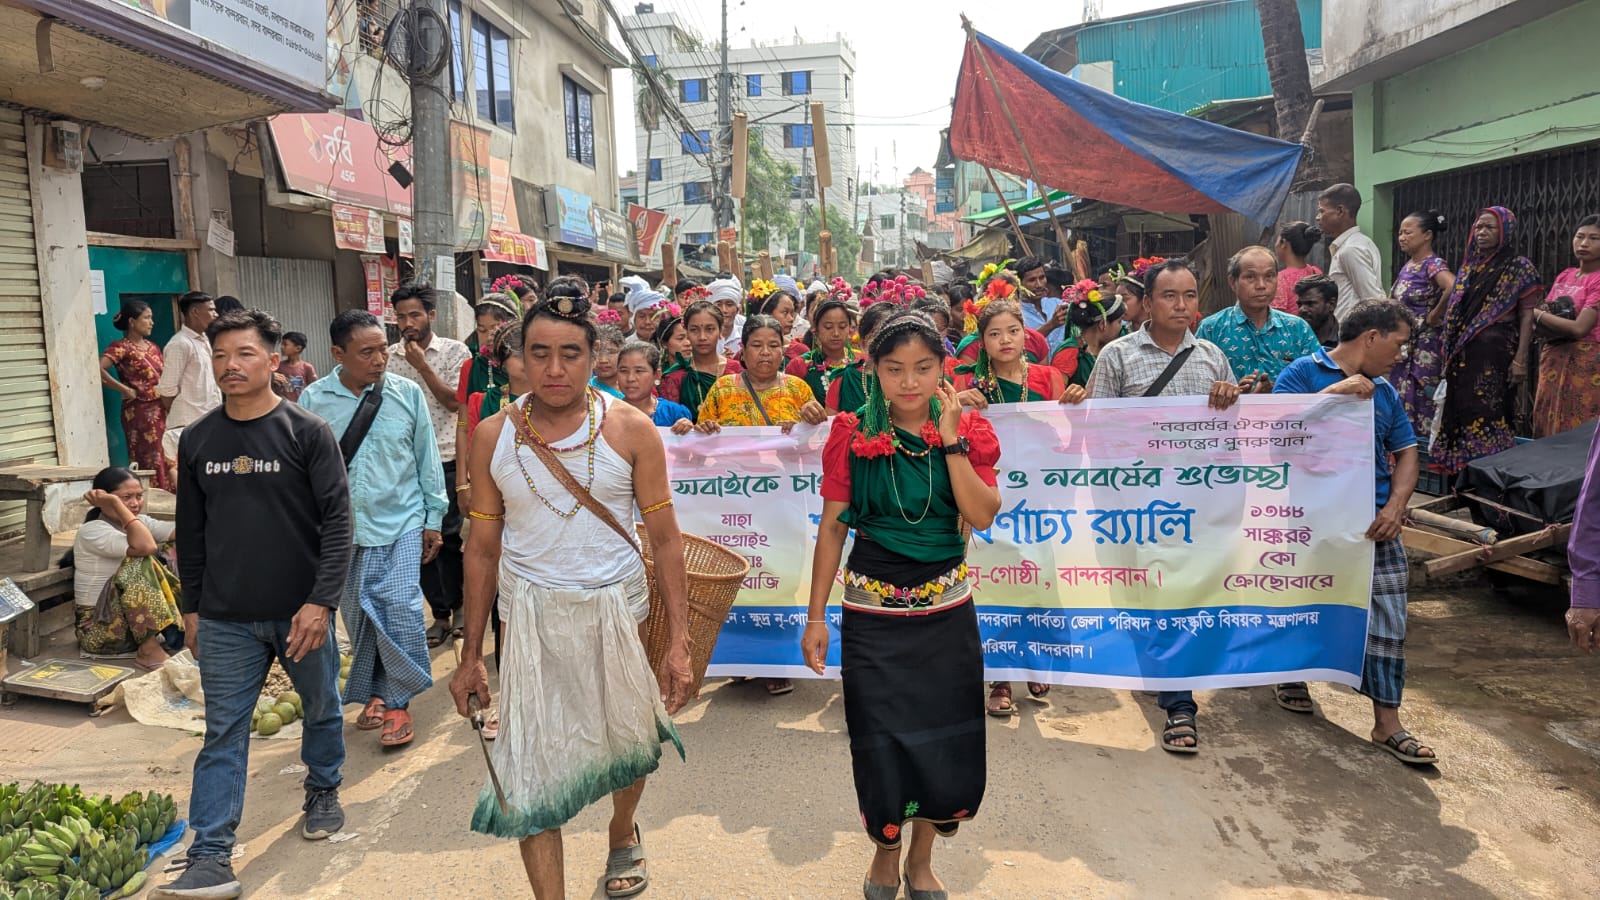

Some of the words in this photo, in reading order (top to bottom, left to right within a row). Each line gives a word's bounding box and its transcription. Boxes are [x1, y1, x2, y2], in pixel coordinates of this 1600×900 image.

[323, 126, 353, 166] রবি
[671, 470, 781, 497] সবাইকে
[790, 472, 824, 494] চা
[1006, 470, 1028, 489] ও
[1040, 460, 1164, 491] নববর্ষের
[1174, 462, 1292, 491] শুভেচ্ছা
[721, 513, 752, 529] মাহা
[1259, 551, 1297, 570] কো
[774, 609, 809, 629] নৃ-গো
[1027, 610, 1067, 630] পার্বত্য
[1071, 613, 1104, 631] জেলা
[1108, 611, 1152, 632] পরিষদ
[1155, 617, 1168, 631] ও
[1218, 609, 1263, 628] বিষয়ক
